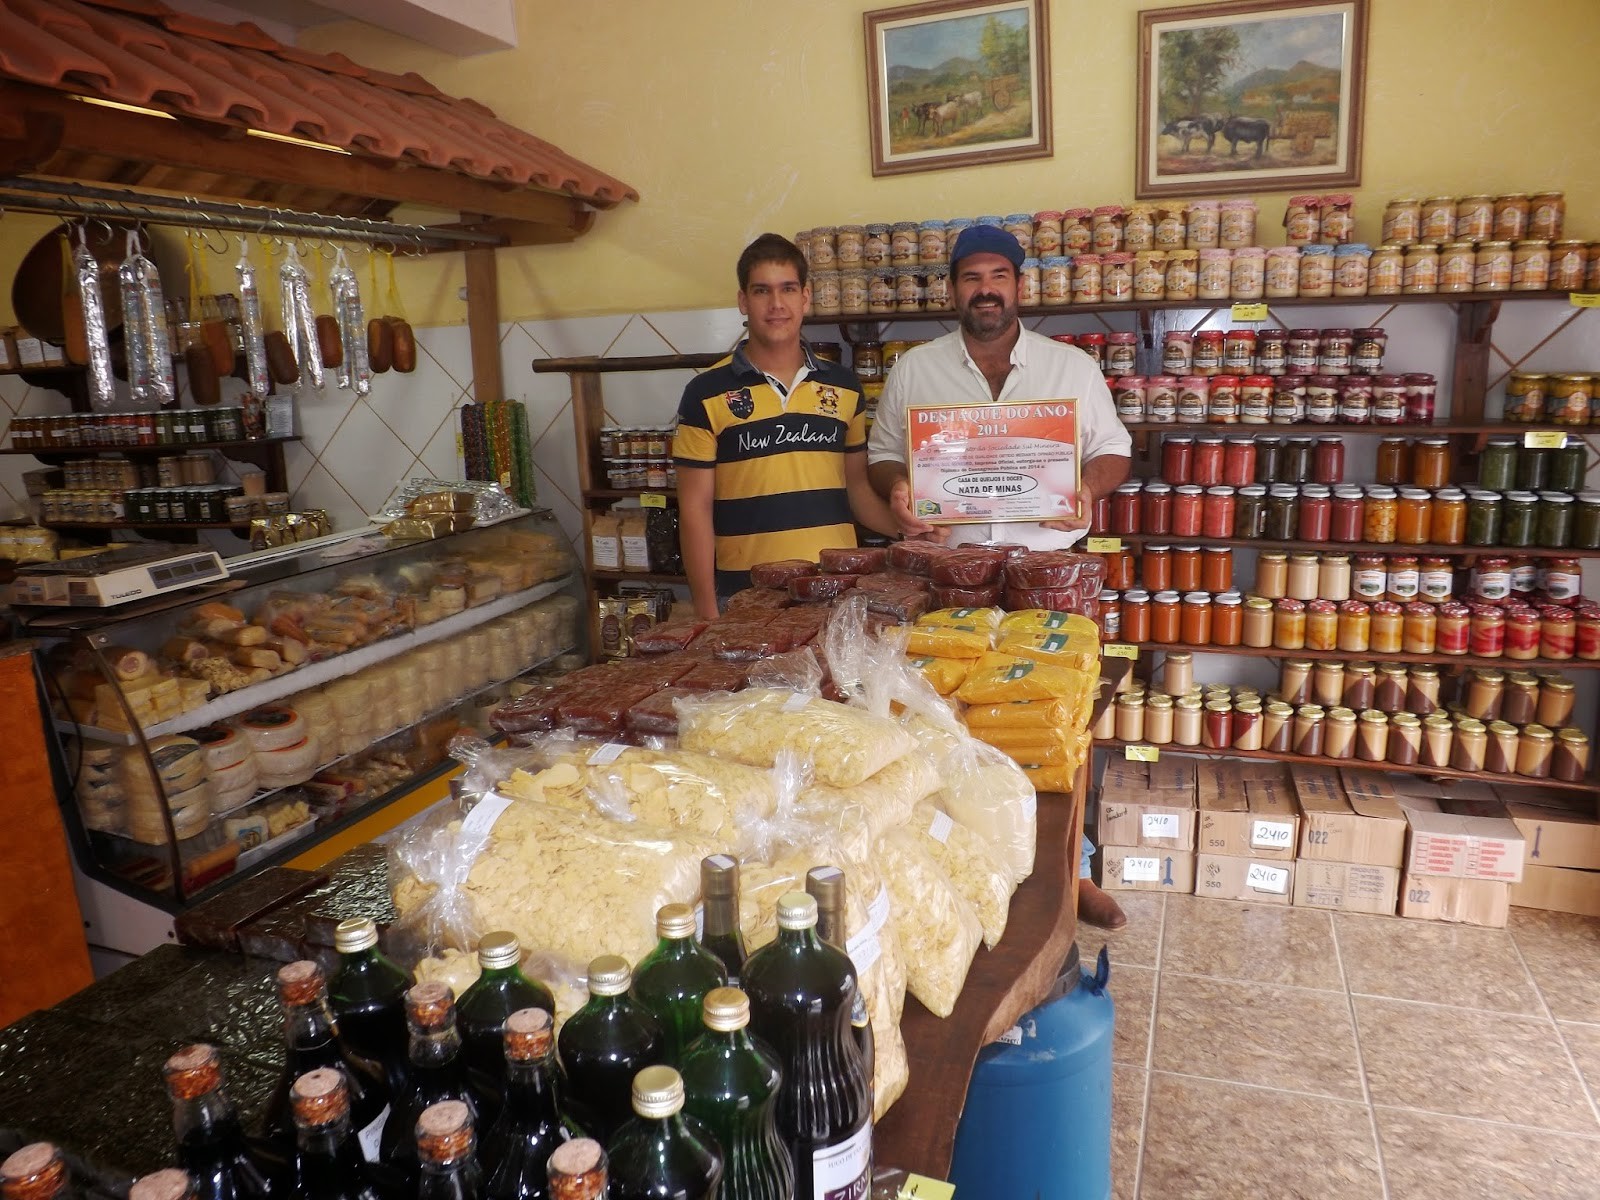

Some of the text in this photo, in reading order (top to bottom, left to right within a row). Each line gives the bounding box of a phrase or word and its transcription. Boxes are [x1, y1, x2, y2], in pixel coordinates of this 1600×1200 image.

[918, 407, 1002, 424] DESTAQUE
[1006, 407, 1029, 420] DO
[977, 424, 1008, 436] 2014
[738, 423, 838, 452] New Zealand
[996, 485, 1022, 493] MINAS
[111, 588, 142, 599] TOLEDO
[1148, 817, 1168, 826] 2410
[1256, 826, 1289, 841] 2410
[1308, 830, 1328, 844] 022
[1130, 860, 1153, 868] 2410
[1250, 868, 1278, 882] 2410
[1409, 890, 1431, 903] 022
